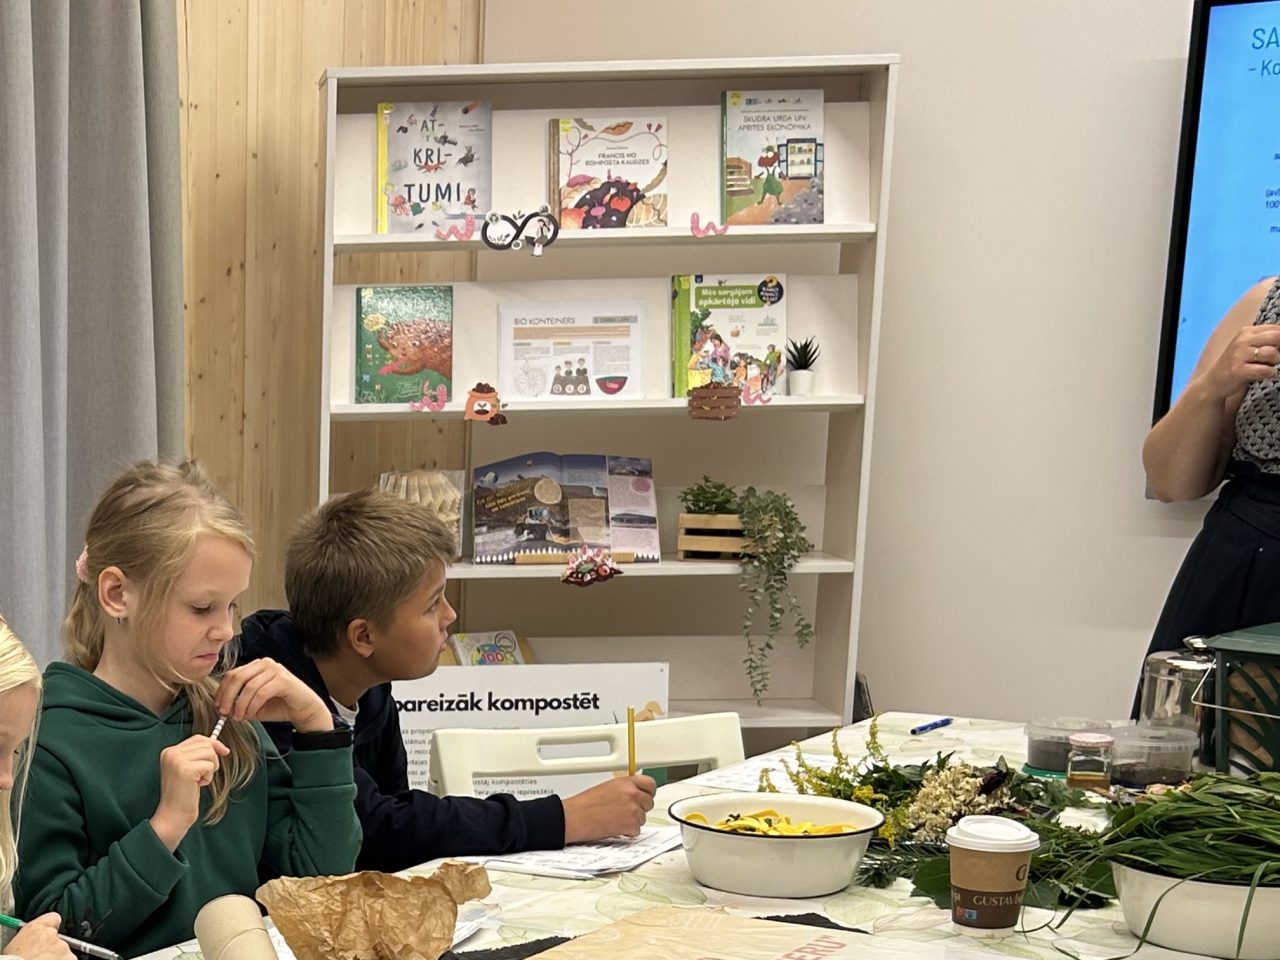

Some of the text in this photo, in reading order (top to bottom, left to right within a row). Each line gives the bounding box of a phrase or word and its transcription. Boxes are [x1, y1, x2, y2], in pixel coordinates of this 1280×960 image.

[404, 182, 461, 202] TUMI
[529, 316, 576, 325] KONTEINERS
[487, 691, 600, 715] kompostēt
